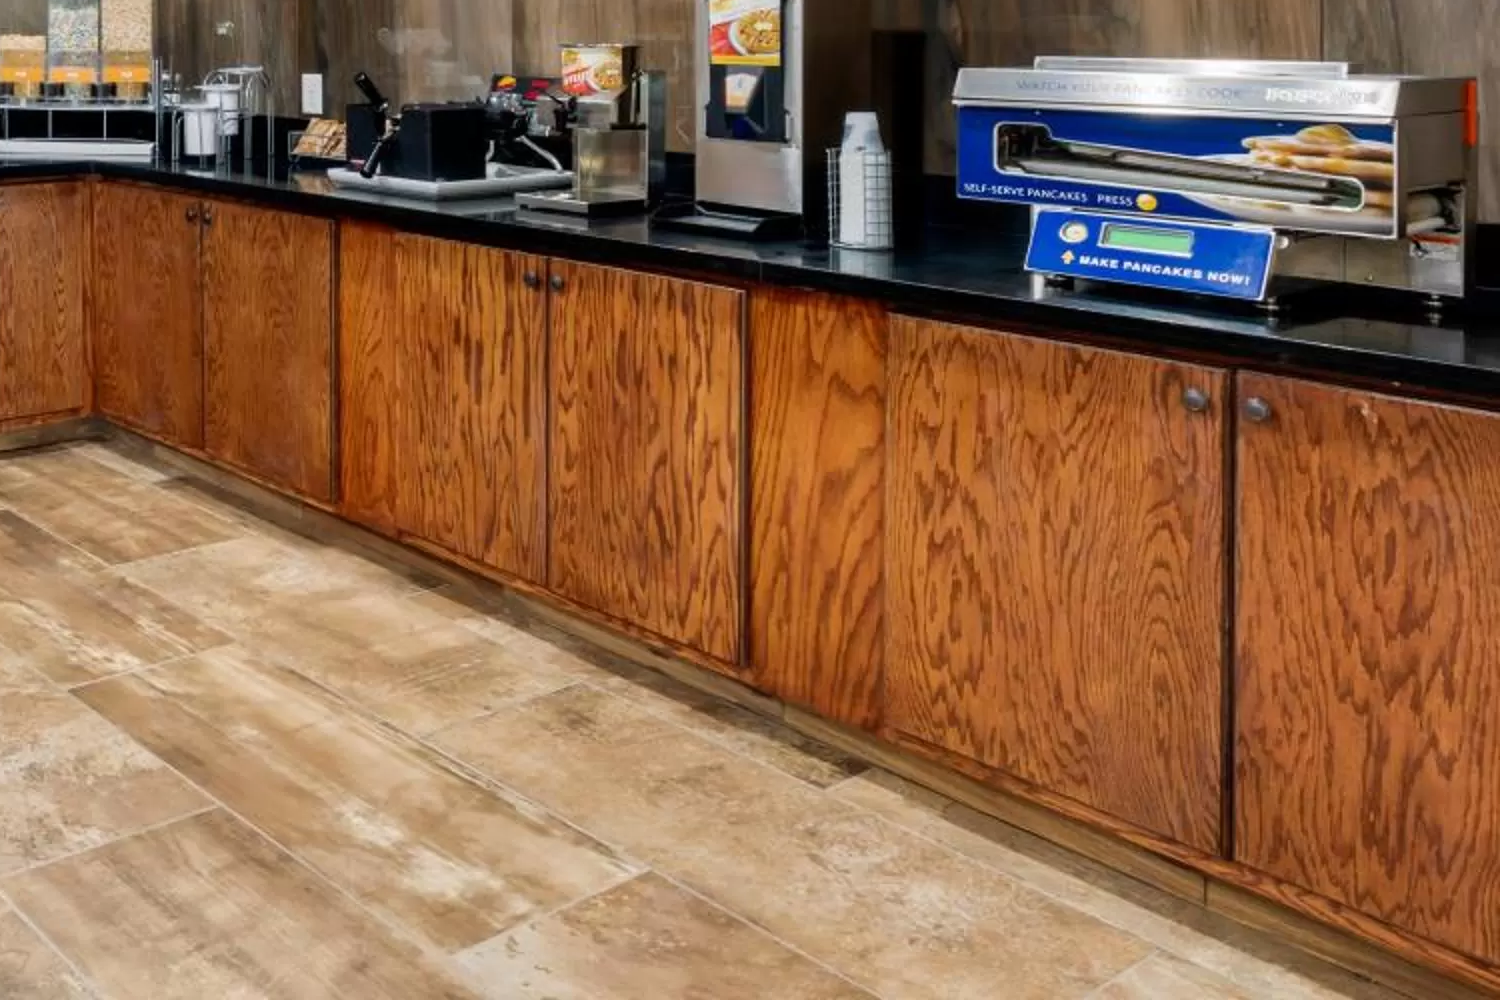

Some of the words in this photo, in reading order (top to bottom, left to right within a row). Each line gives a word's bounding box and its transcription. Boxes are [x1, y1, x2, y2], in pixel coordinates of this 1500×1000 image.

[963, 183, 1025, 197] SELF-SERVE
[1027, 187, 1088, 202] PANCAKES
[1097, 193, 1133, 207] PRESS
[1079, 255, 1123, 269] MAKE
[1124, 261, 1203, 280] PANCAKES
[1207, 271, 1251, 286] NOW!
